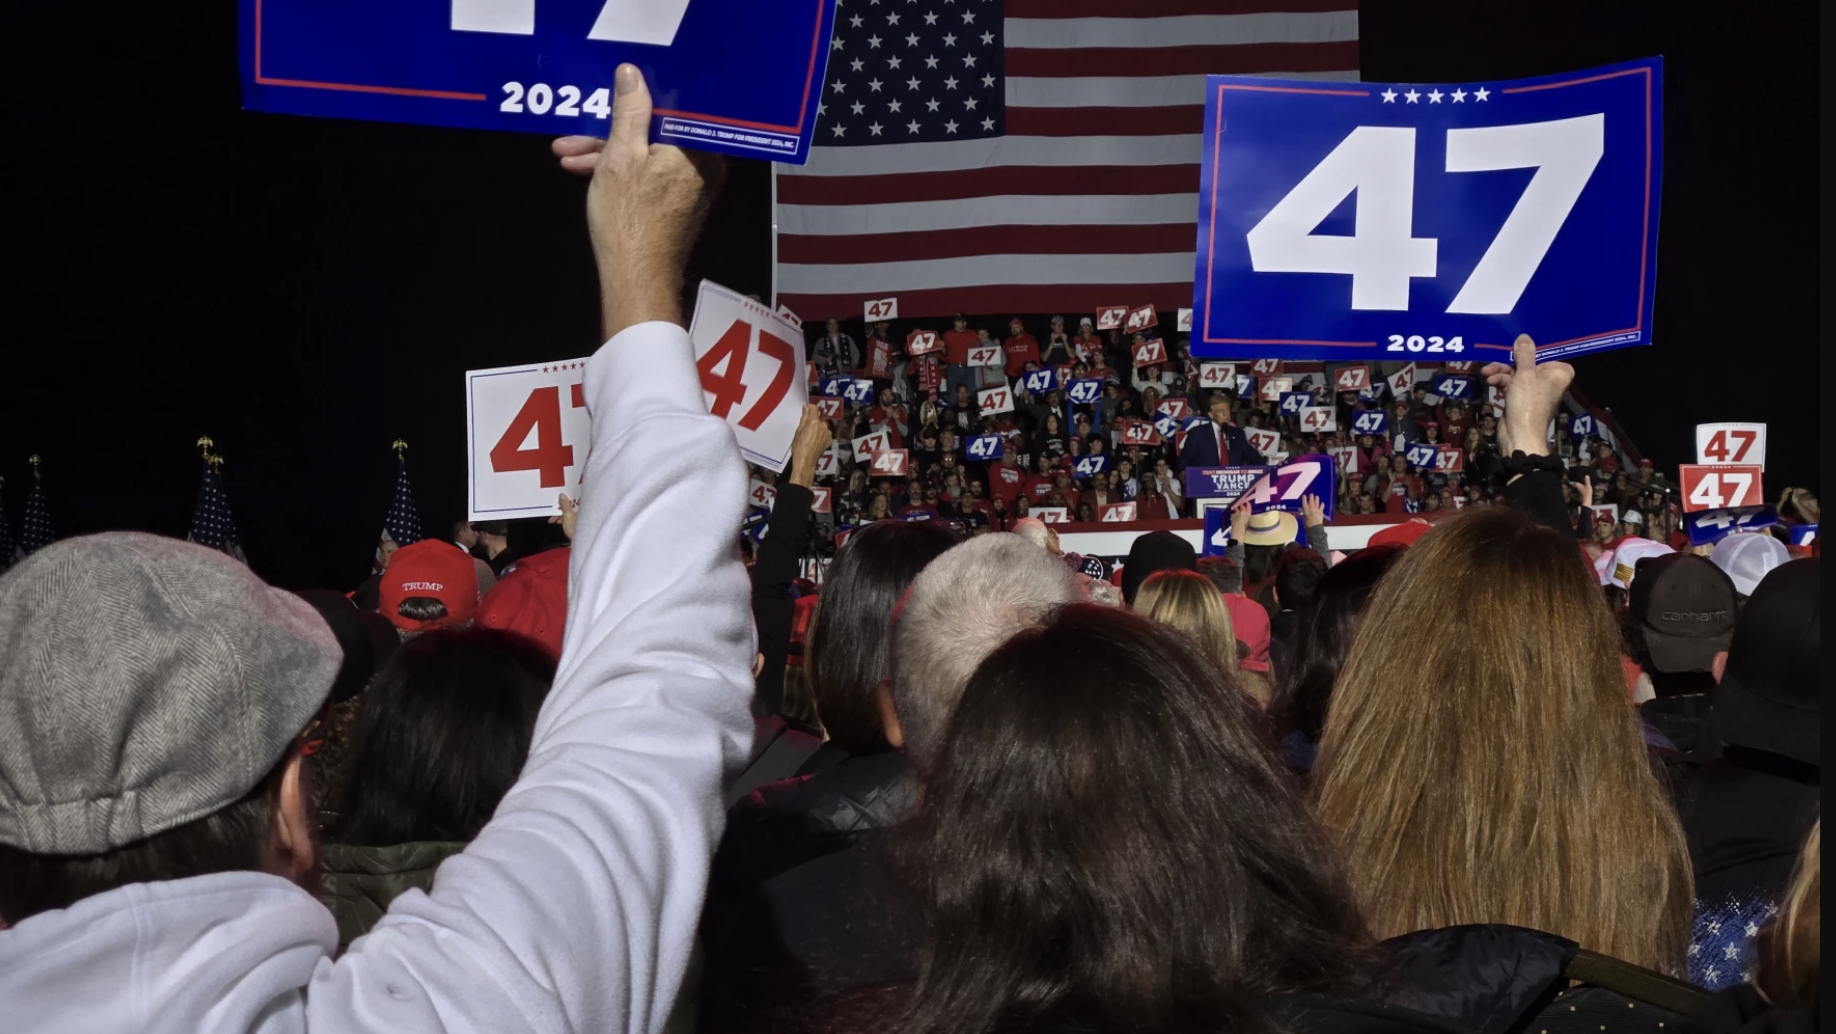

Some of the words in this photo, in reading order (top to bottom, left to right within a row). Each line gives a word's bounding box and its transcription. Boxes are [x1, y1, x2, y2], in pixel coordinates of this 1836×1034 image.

[500, 82, 611, 119] 2024
[1247, 113, 1604, 314] 47
[868, 301, 893, 317] 47
[1100, 309, 1126, 326] 47
[1128, 308, 1151, 328] 47
[911, 333, 936, 350] 47
[1387, 334, 1464, 353] 2024
[971, 349, 997, 362] 47
[1136, 342, 1160, 362] 47
[696, 318, 795, 431] 47
[1204, 367, 1230, 383] 47
[1254, 359, 1278, 373] 47
[1026, 370, 1051, 390] 47
[1338, 369, 1365, 386] 47
[1395, 367, 1414, 389] 47
[844, 382, 869, 400] 47
[1070, 382, 1098, 399] 47
[1261, 380, 1288, 397] 47
[1438, 378, 1467, 396] 47
[982, 390, 1007, 410] 47
[1157, 401, 1184, 417] 47
[1282, 394, 1309, 412] 47
[1155, 416, 1181, 437] 47
[1304, 410, 1331, 427] 47
[1355, 413, 1383, 431] 47
[1573, 418, 1592, 435] 47
[1127, 424, 1153, 441] 47
[858, 434, 883, 455] 47
[969, 436, 998, 456] 47
[1704, 430, 1757, 462] 47
[874, 453, 904, 472] 47
[1076, 456, 1105, 475] 47
[1406, 447, 1434, 466] 47
[1435, 451, 1459, 469] 47
[1211, 474, 1255, 484] TRUMP
[1231, 462, 1321, 510] 47
[1689, 473, 1752, 508] 47
[1102, 505, 1132, 522] 47
[402, 581, 444, 593] TRUMP
